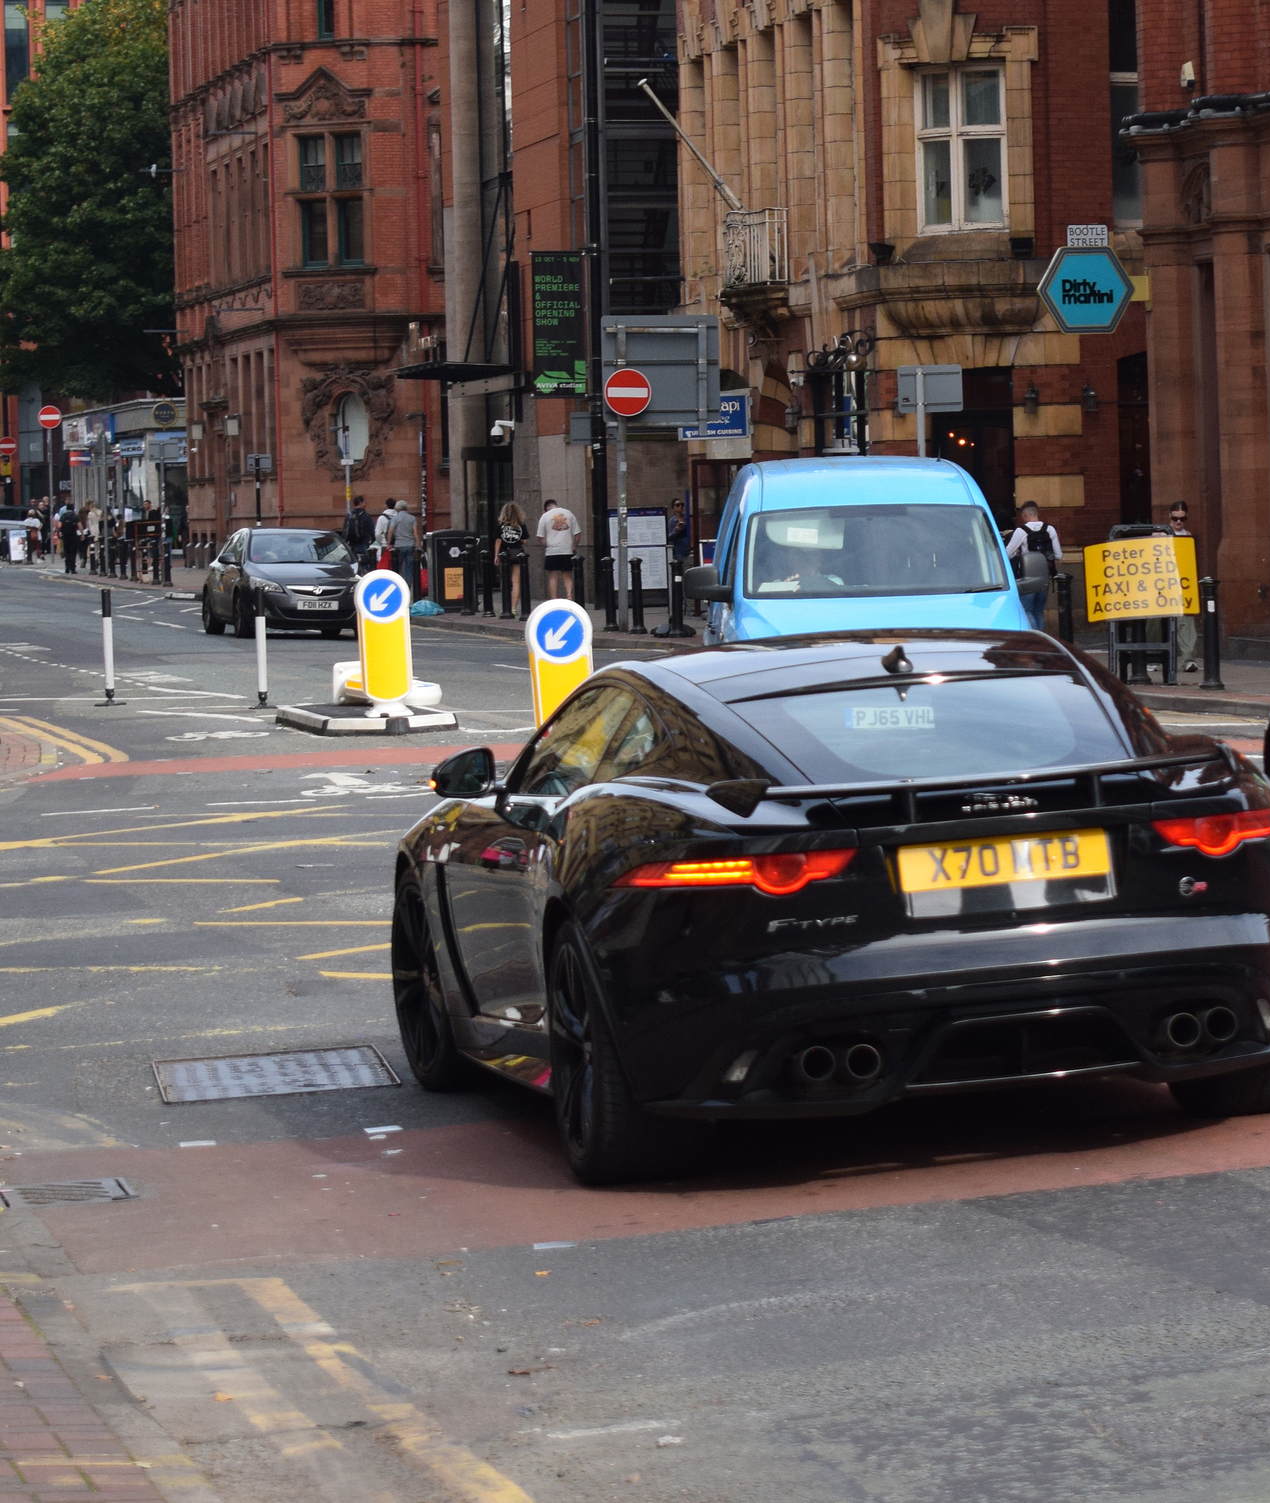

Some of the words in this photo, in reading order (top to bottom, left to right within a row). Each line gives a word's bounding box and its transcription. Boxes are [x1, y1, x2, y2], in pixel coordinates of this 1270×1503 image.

[1069, 227, 1105, 236] BOOTLE
[1070, 238, 1105, 247] STREET
[1062, 279, 1097, 295] Dirty
[1062, 290, 1114, 304] martini
[535, 318, 559, 326] SHOW
[1102, 548, 1145, 562] Peter
[1103, 561, 1177, 578] CLOSED
[1092, 580, 1130, 597] TAXI
[1137, 579, 1148, 592] &
[1154, 577, 1190, 592] CPC
[1093, 599, 1150, 615] Access
[1155, 594, 1193, 609] Only
[855, 709, 899, 726] PJ65
[928, 845, 1000, 882] X70
[1010, 837, 1080, 874] MTB
[767, 914, 859, 932] F-TYPE
